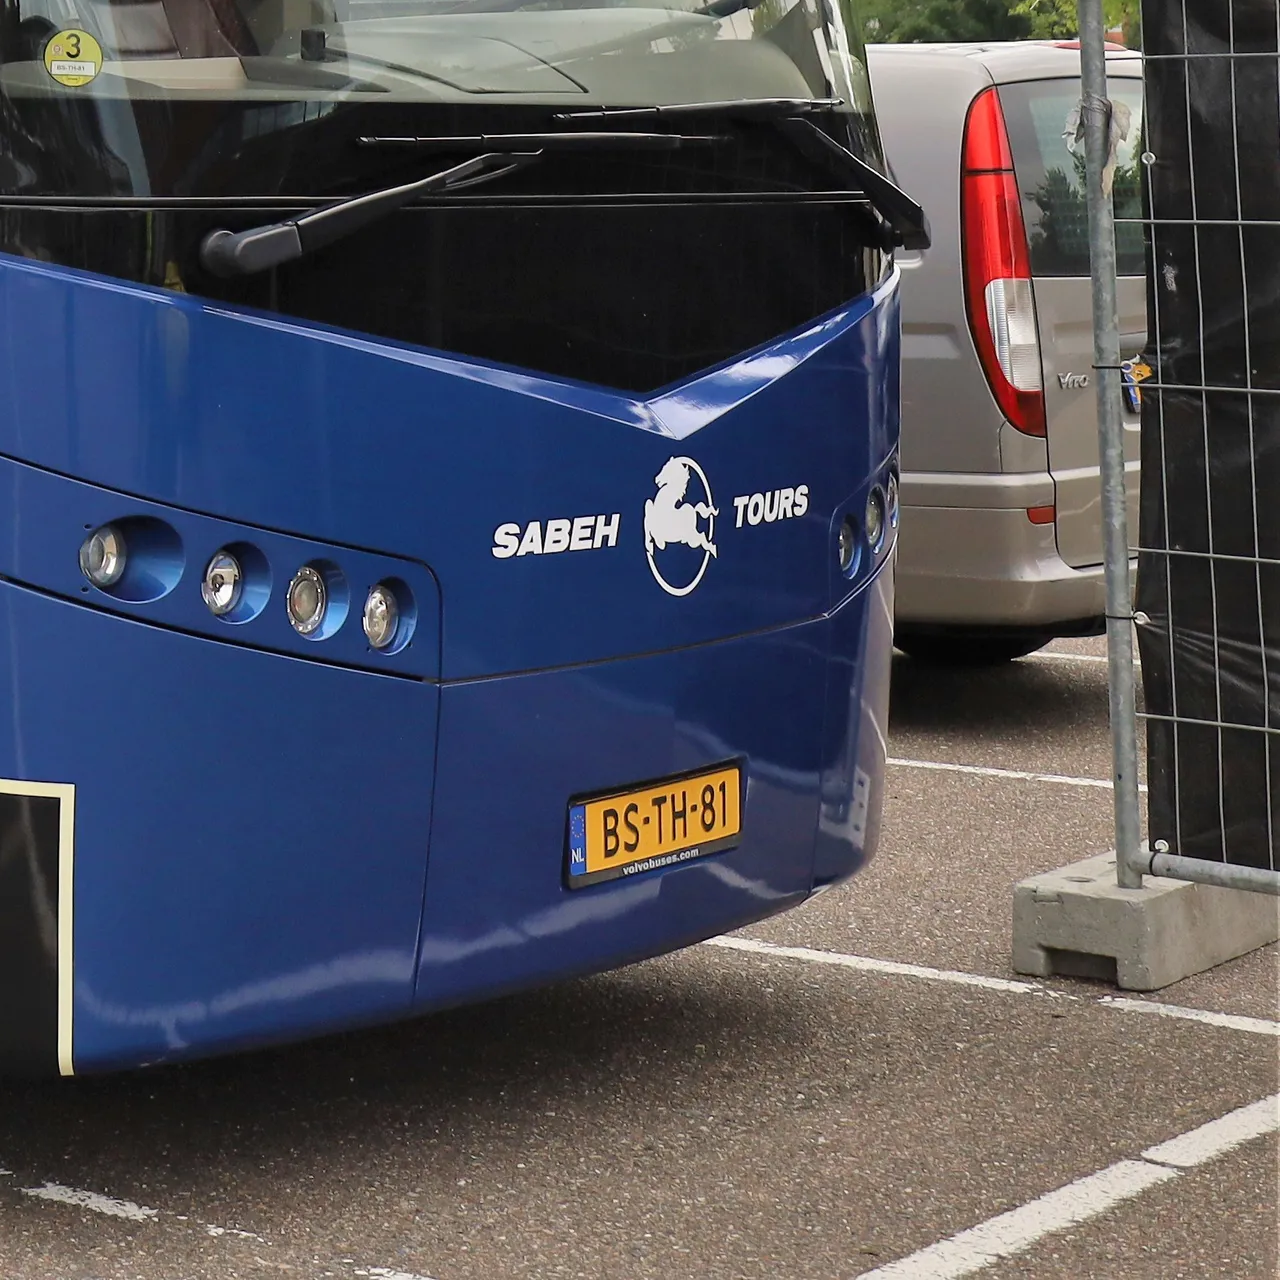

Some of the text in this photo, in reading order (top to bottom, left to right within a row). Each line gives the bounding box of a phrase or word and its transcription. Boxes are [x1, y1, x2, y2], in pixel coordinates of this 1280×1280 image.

[66, 33, 81, 59] 3
[56, 64, 86, 72] BS-TH-81
[491, 484, 810, 559] SABEH TOURS
[603, 780, 727, 859] BS-TH-81
[571, 847, 585, 865] NL
[623, 848, 700, 876] volvobuses.com
